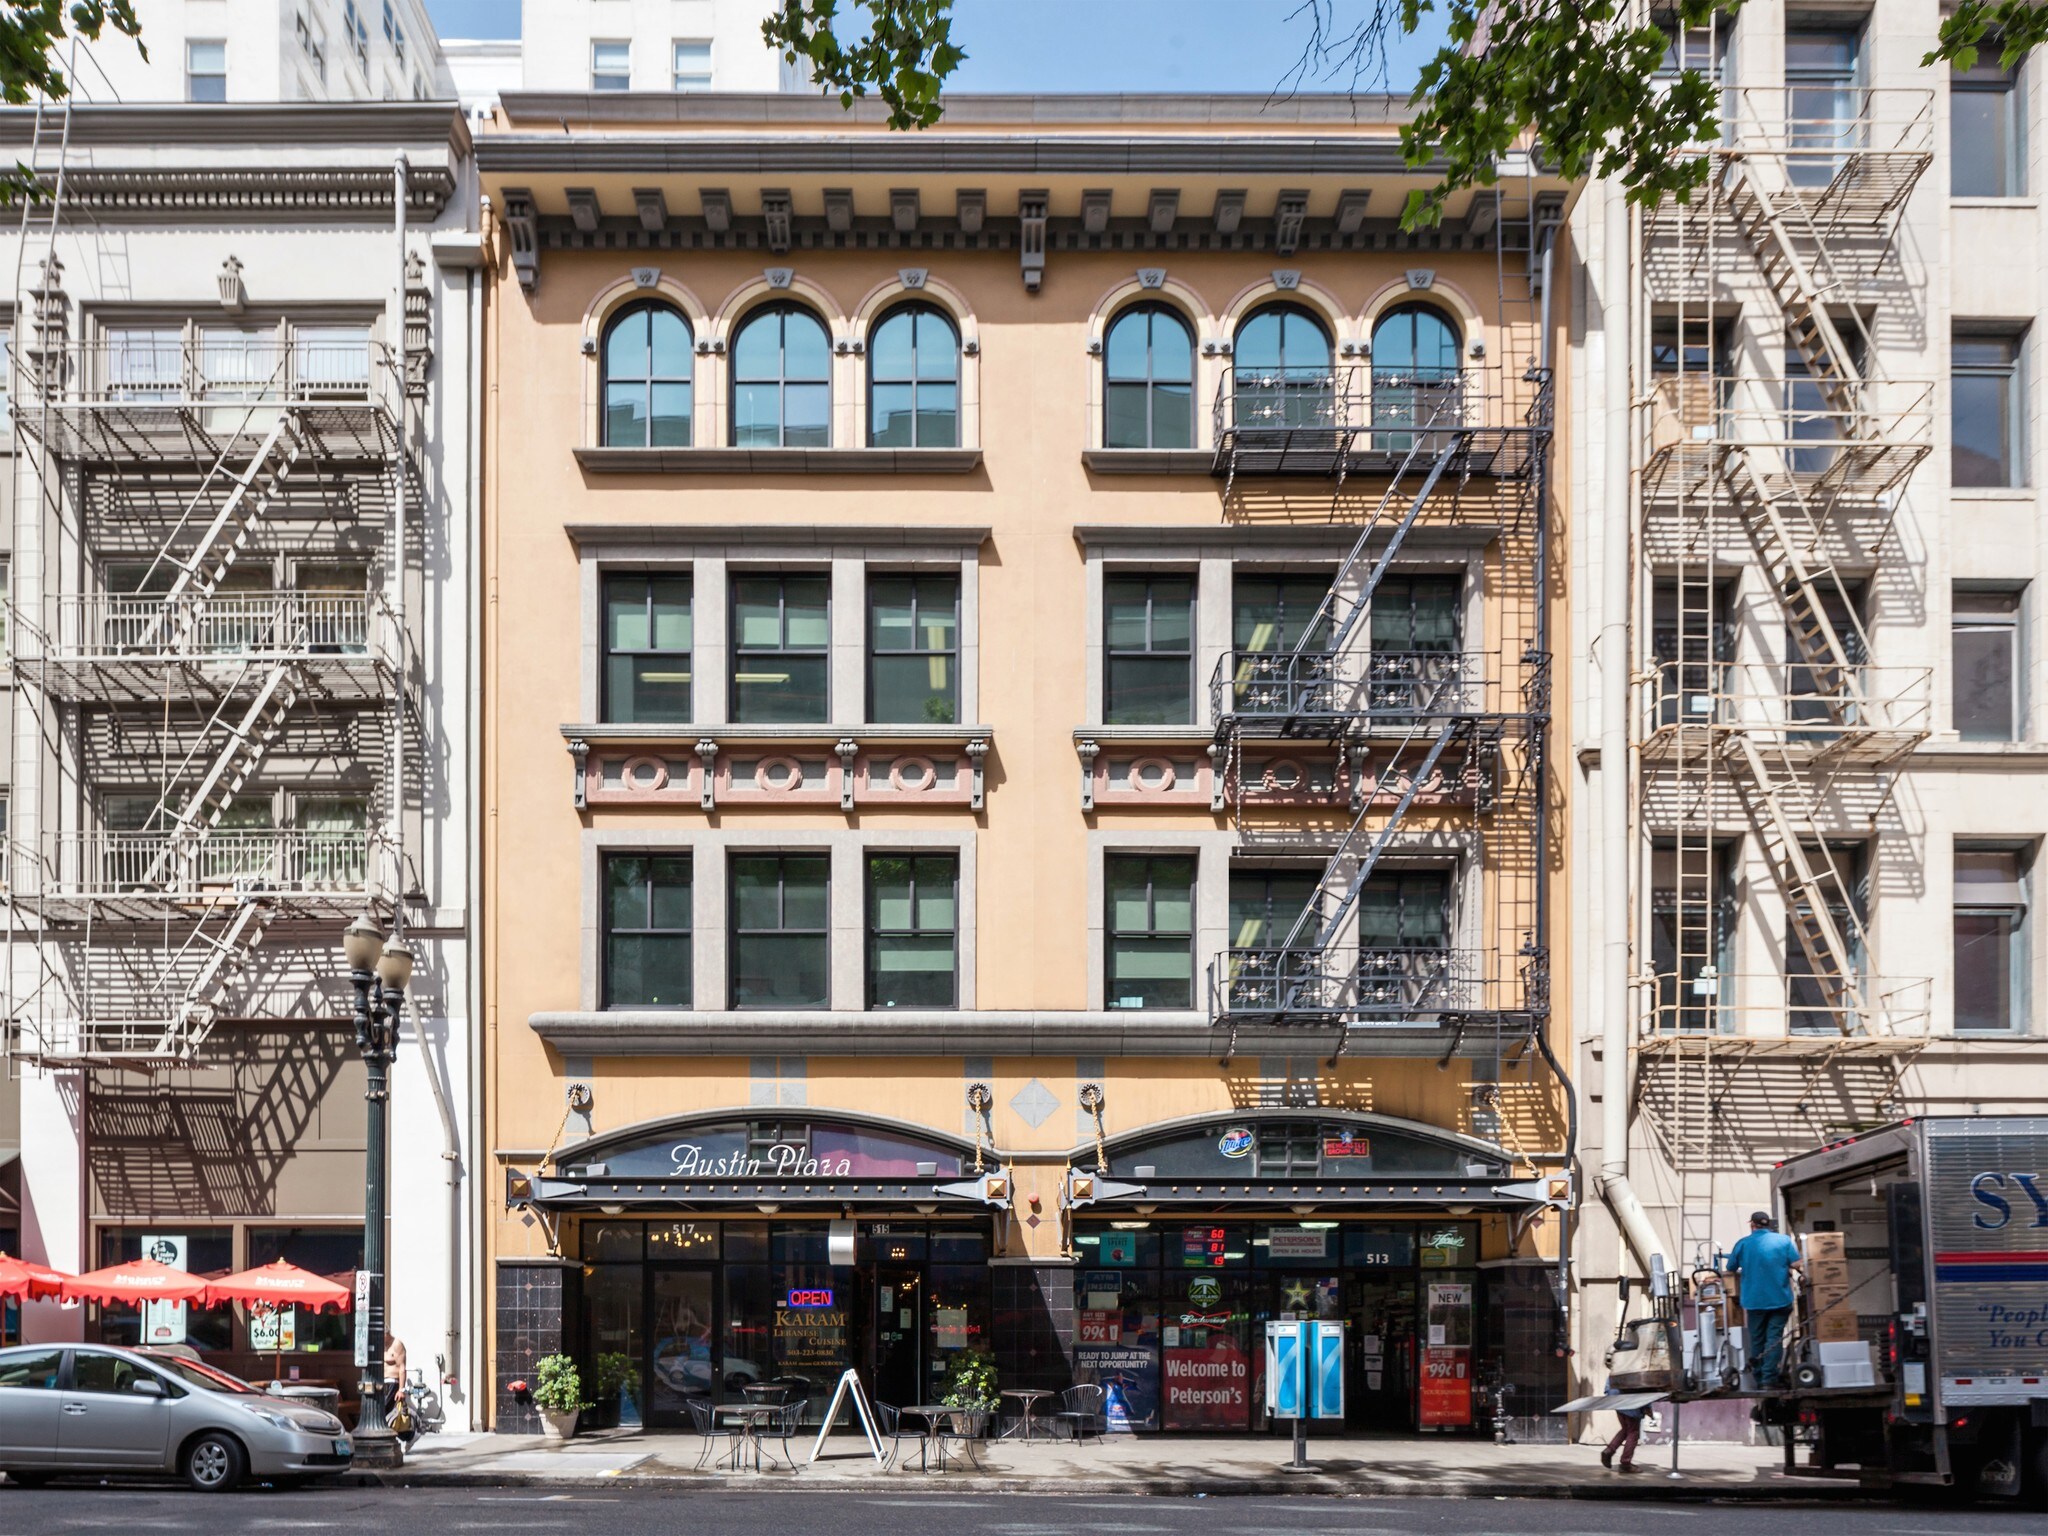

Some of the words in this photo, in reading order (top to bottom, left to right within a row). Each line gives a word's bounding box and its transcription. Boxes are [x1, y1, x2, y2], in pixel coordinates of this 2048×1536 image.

[670, 1144, 761, 1177] Austin
[767, 1144, 851, 1177] Plaza
[672, 1224, 695, 1235] 517
[872, 1224, 889, 1233] 515
[1210, 1229, 1225, 1239] 60
[1210, 1243, 1225, 1252] 81
[1366, 1253, 1390, 1264] 513
[791, 1291, 831, 1306] OPEN
[1438, 1293, 1462, 1303] NEW
[774, 1310, 846, 1326] KARAM
[1082, 1325, 1106, 1340] 99¢
[809, 1337, 847, 1346] CUISINE
[1988, 1329, 2026, 1348] You
[1078, 1351, 1100, 1360] READY
[1101, 1351, 1110, 1360] TO
[1110, 1351, 1129, 1361] JUMP
[1129, 1351, 1137, 1360] AT
[1138, 1351, 1151, 1360] THE
[1081, 1360, 1098, 1369] NEXT
[1099, 1360, 1148, 1369] OPPORTUNITY?
[1166, 1359, 1229, 1377] Welcome
[1231, 1360, 1246, 1377] to
[1429, 1363, 1452, 1378] 99¢
[1170, 1386, 1242, 1404] Peterson's
